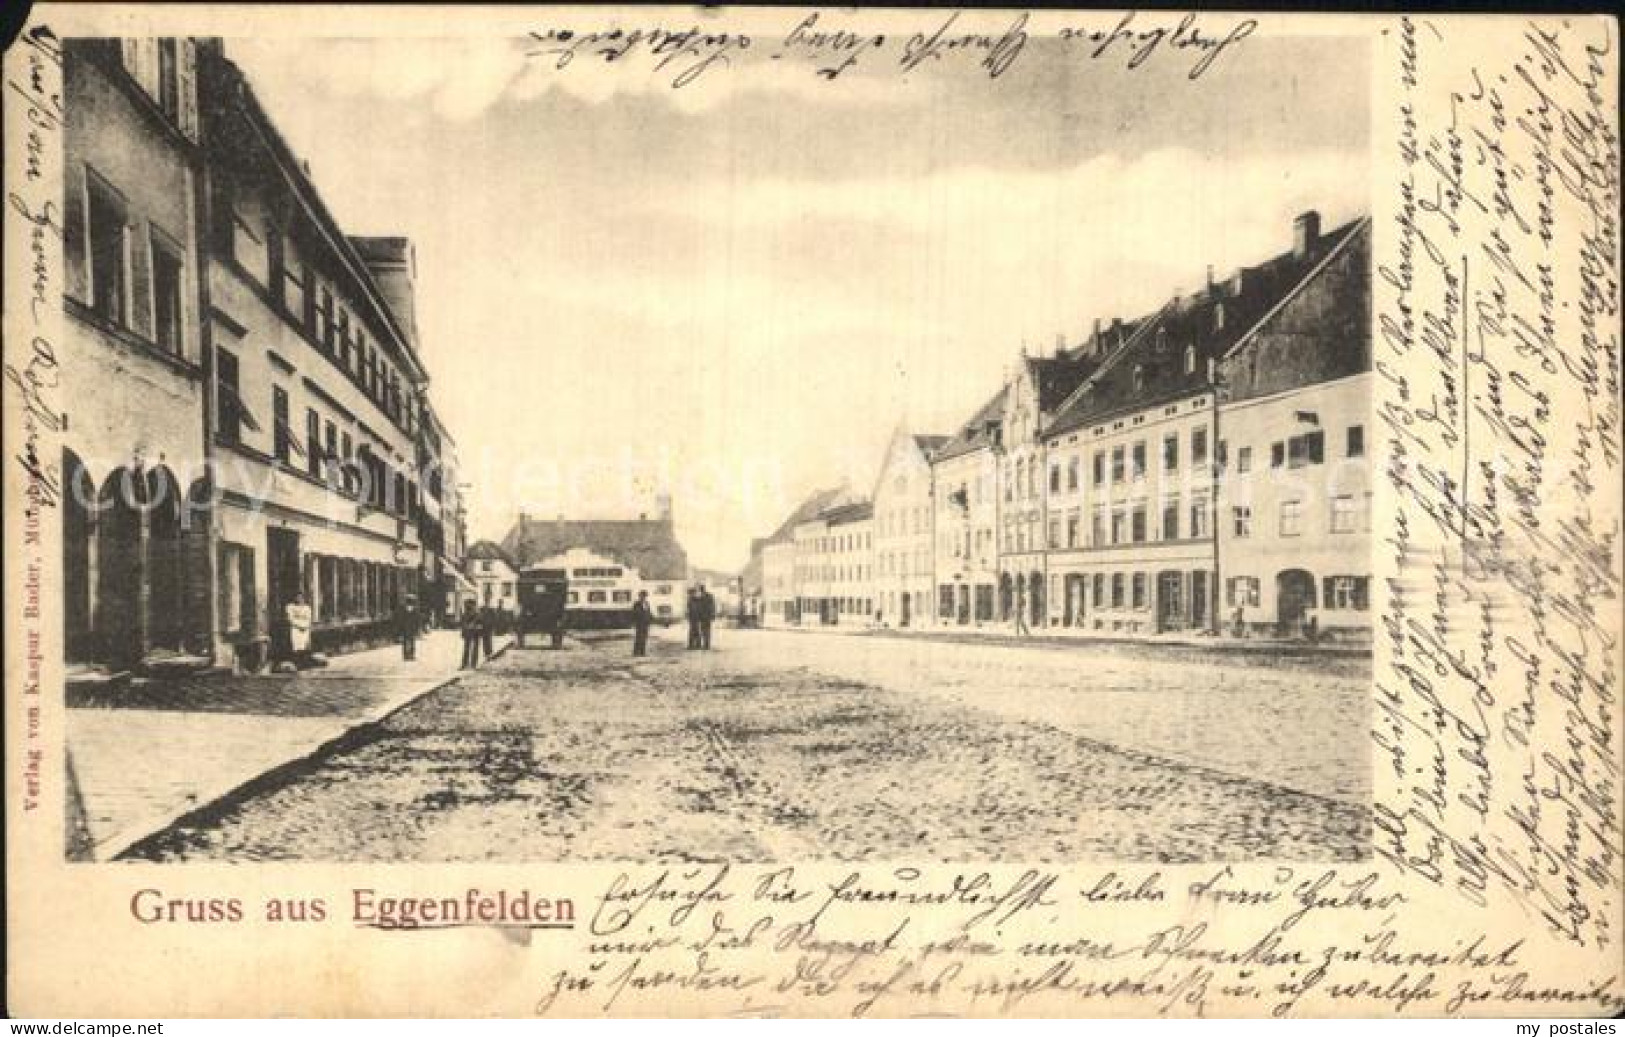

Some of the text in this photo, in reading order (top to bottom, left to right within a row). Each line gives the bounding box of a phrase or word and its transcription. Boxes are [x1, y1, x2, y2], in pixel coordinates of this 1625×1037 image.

[24, 630, 42, 696] Kaspar
[27, 707, 39, 739] von
[23, 750, 42, 812] Verlag
[129, 888, 576, 930] Gruss aus Eggenfelden
